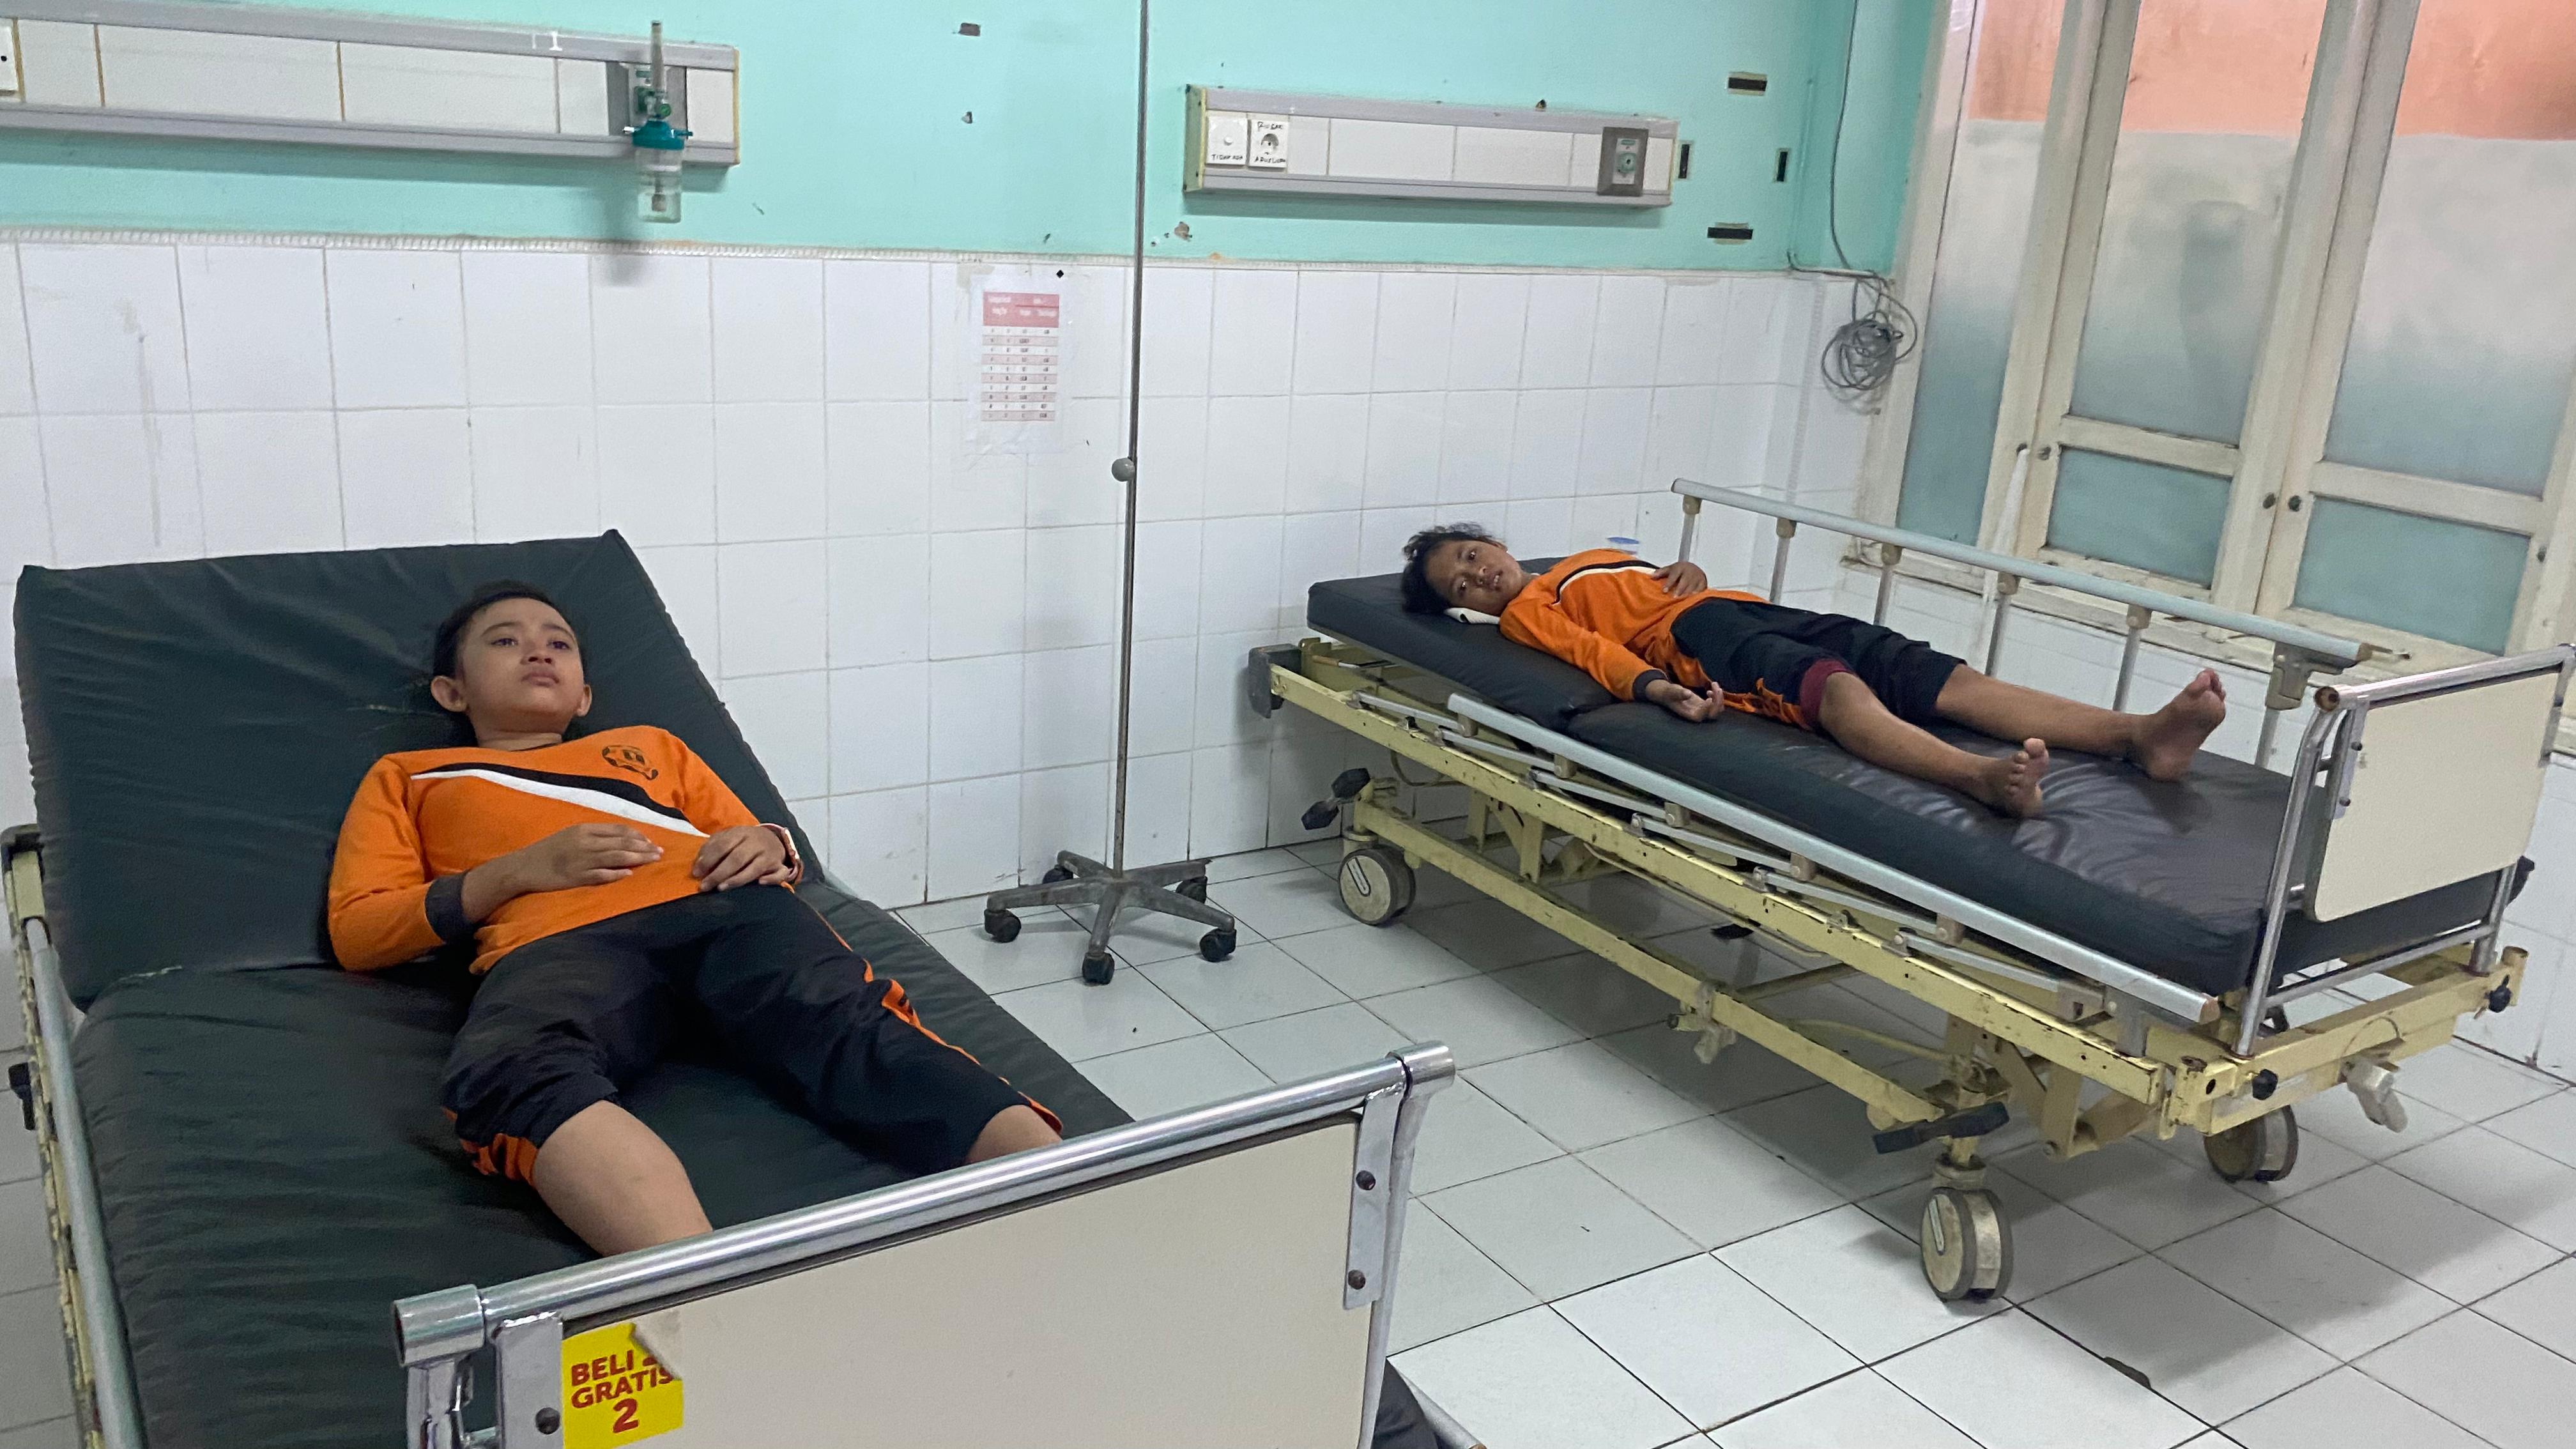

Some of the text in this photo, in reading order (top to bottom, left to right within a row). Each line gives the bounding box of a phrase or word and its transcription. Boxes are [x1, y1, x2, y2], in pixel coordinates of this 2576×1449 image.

[571, 1349, 634, 1386] BELI
[571, 1367, 675, 1409] GRATIS
[612, 1397, 640, 1434] 2
